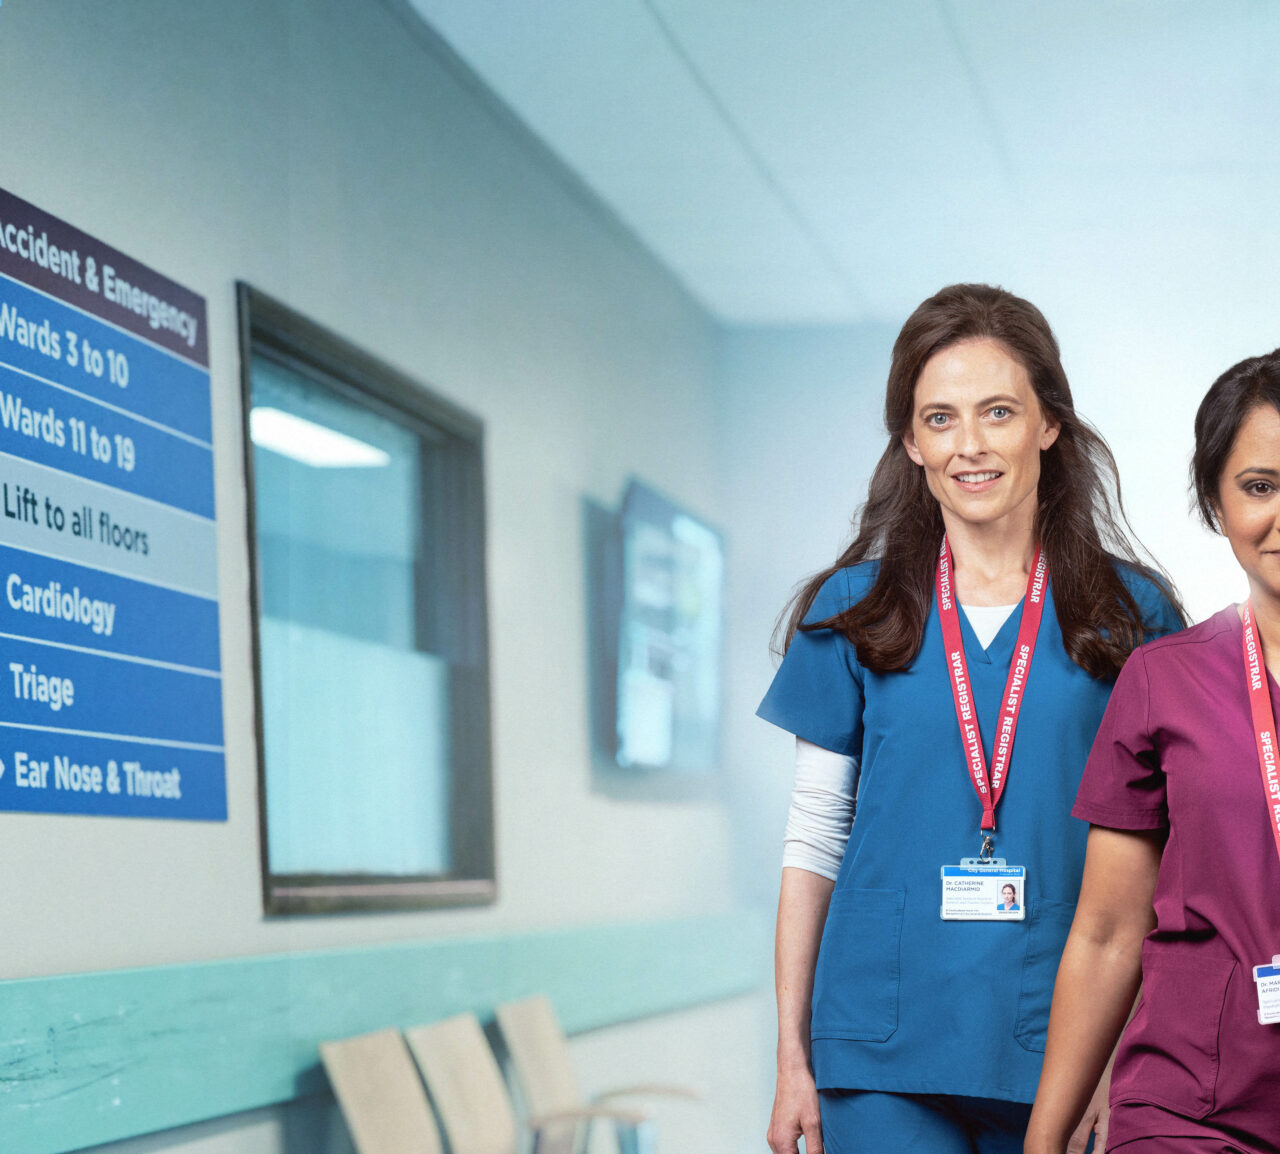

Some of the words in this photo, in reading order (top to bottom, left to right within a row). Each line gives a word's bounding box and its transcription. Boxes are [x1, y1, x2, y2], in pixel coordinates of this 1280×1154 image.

[85, 256, 100, 293] &
[102, 264, 198, 348] Emergency
[0, 302, 62, 360] Wards
[65, 330, 78, 368] 3
[82, 338, 104, 378] to
[107, 349, 129, 389] 10
[0, 390, 66, 448] Wards
[69, 417, 87, 455] 11
[90, 425, 112, 464] to
[114, 434, 136, 472] 19
[3, 482, 39, 525] Lift
[45, 496, 65, 532] to
[72, 505, 94, 540] all
[99, 510, 150, 556] floors
[6, 572, 116, 637] Cardiology
[940, 556, 952, 611] SPECIALIST
[9, 662, 75, 712] Triage
[951, 651, 972, 721] REGISTRAR
[1006, 644, 1030, 714] SPECIALIST
[1245, 627, 1262, 691] REGISTRAR
[14, 751, 50, 789] Ear
[54, 755, 103, 794] Nose
[106, 759, 121, 794] &
[122, 761, 182, 800] Throat
[964, 724, 988, 794] SPECIALIST
[991, 716, 1014, 789] REGISTRAR
